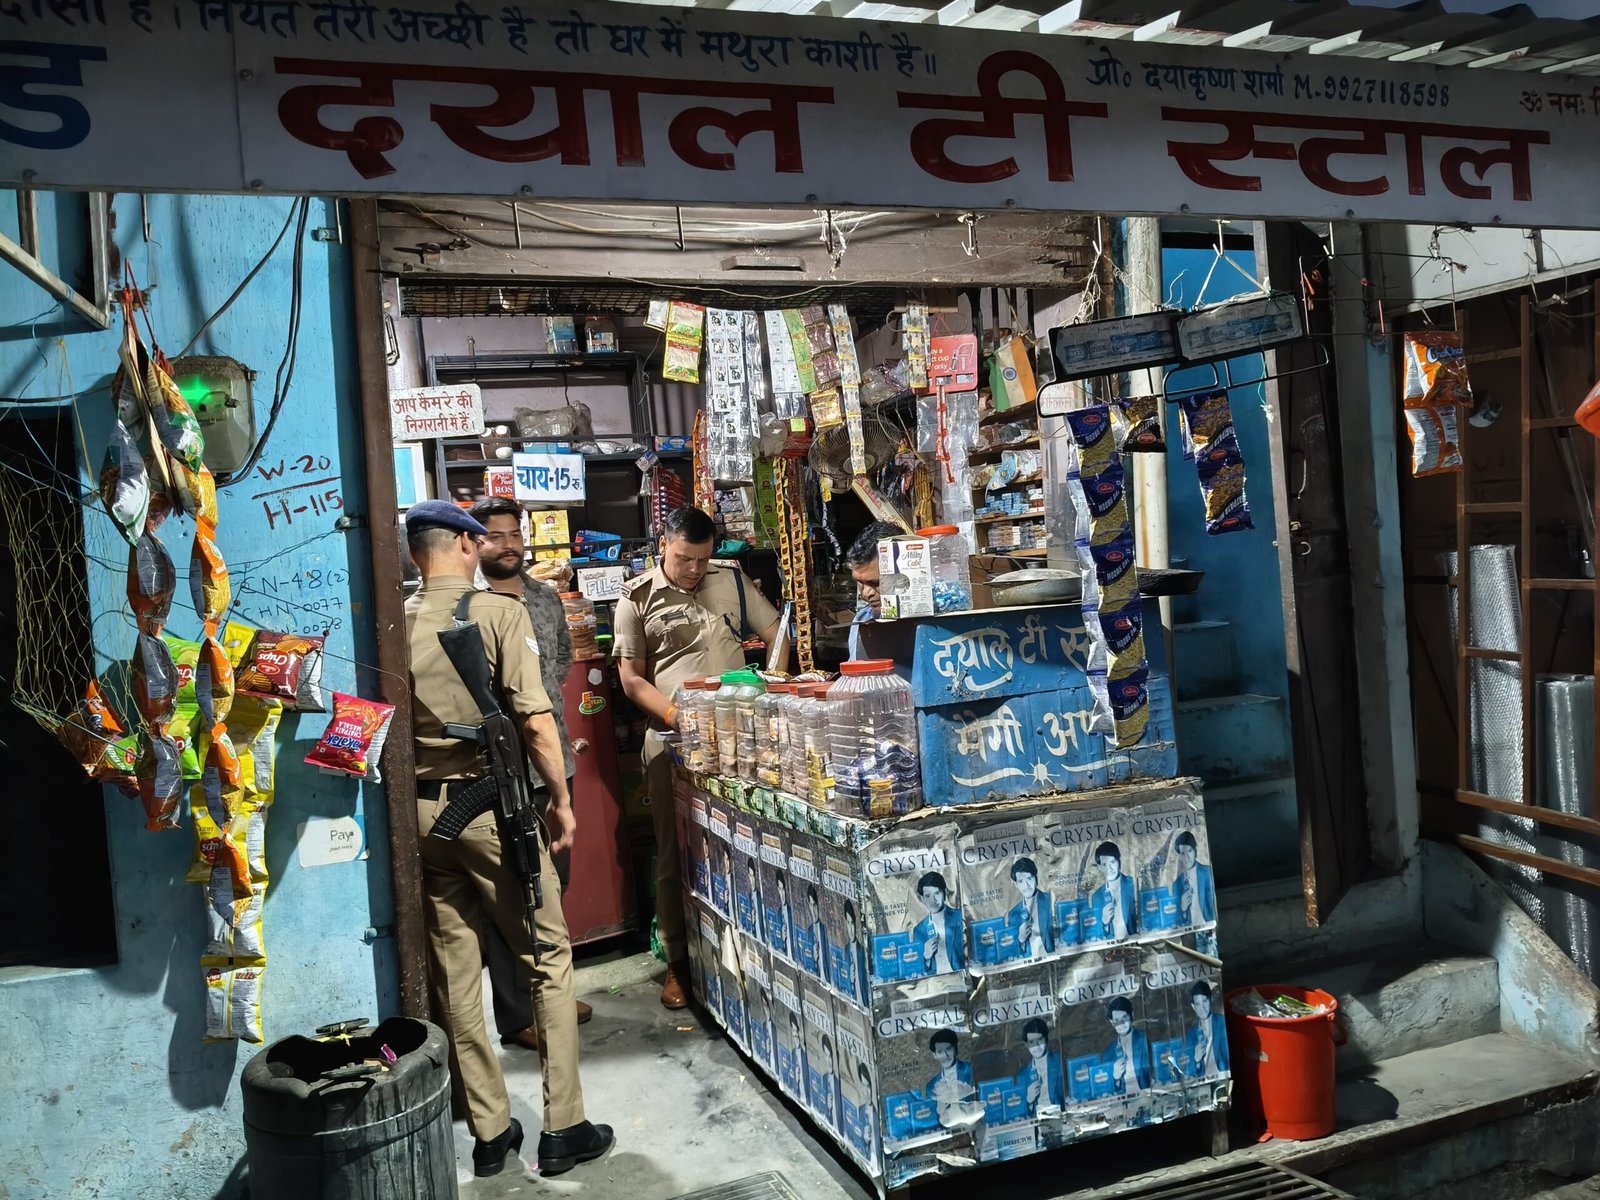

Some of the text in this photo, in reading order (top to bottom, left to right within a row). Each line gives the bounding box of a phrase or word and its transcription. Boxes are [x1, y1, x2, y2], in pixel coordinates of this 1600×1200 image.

[380, 3, 489, 49] अच्छी
[500, 7, 538, 55] है
[548, 11, 590, 53] तो
[603, 24, 652, 59] घर
[655, 17, 688, 59] में
[697, 29, 792, 73] मथुरा
[799, 31, 885, 73] काशी
[1243, 62, 1285, 98] शर्मा
[274, 50, 1551, 202] दयाल टी स्टाल
[457, 390, 474, 410] की
[404, 412, 449, 433] निगरानी
[495, 485, 513, 494] ROS
[263, 489, 344, 530] H-115
[257, 652, 288, 665] Chips
[330, 829, 353, 842] Pay
[1050, 822, 1125, 846] CRYSTAL
[1132, 811, 1201, 836] CRYSTAL
[868, 849, 952, 876] CRYSTAL
[963, 837, 1042, 864] CRYSTAL
[823, 871, 858, 900] CRYSTAL
[1148, 964, 1216, 988] CRYSTAL
[1063, 976, 1137, 1003] CRYSTAL
[879, 1006, 963, 1036] CRYSTAL
[975, 999, 1053, 1025] CRYSTAL
